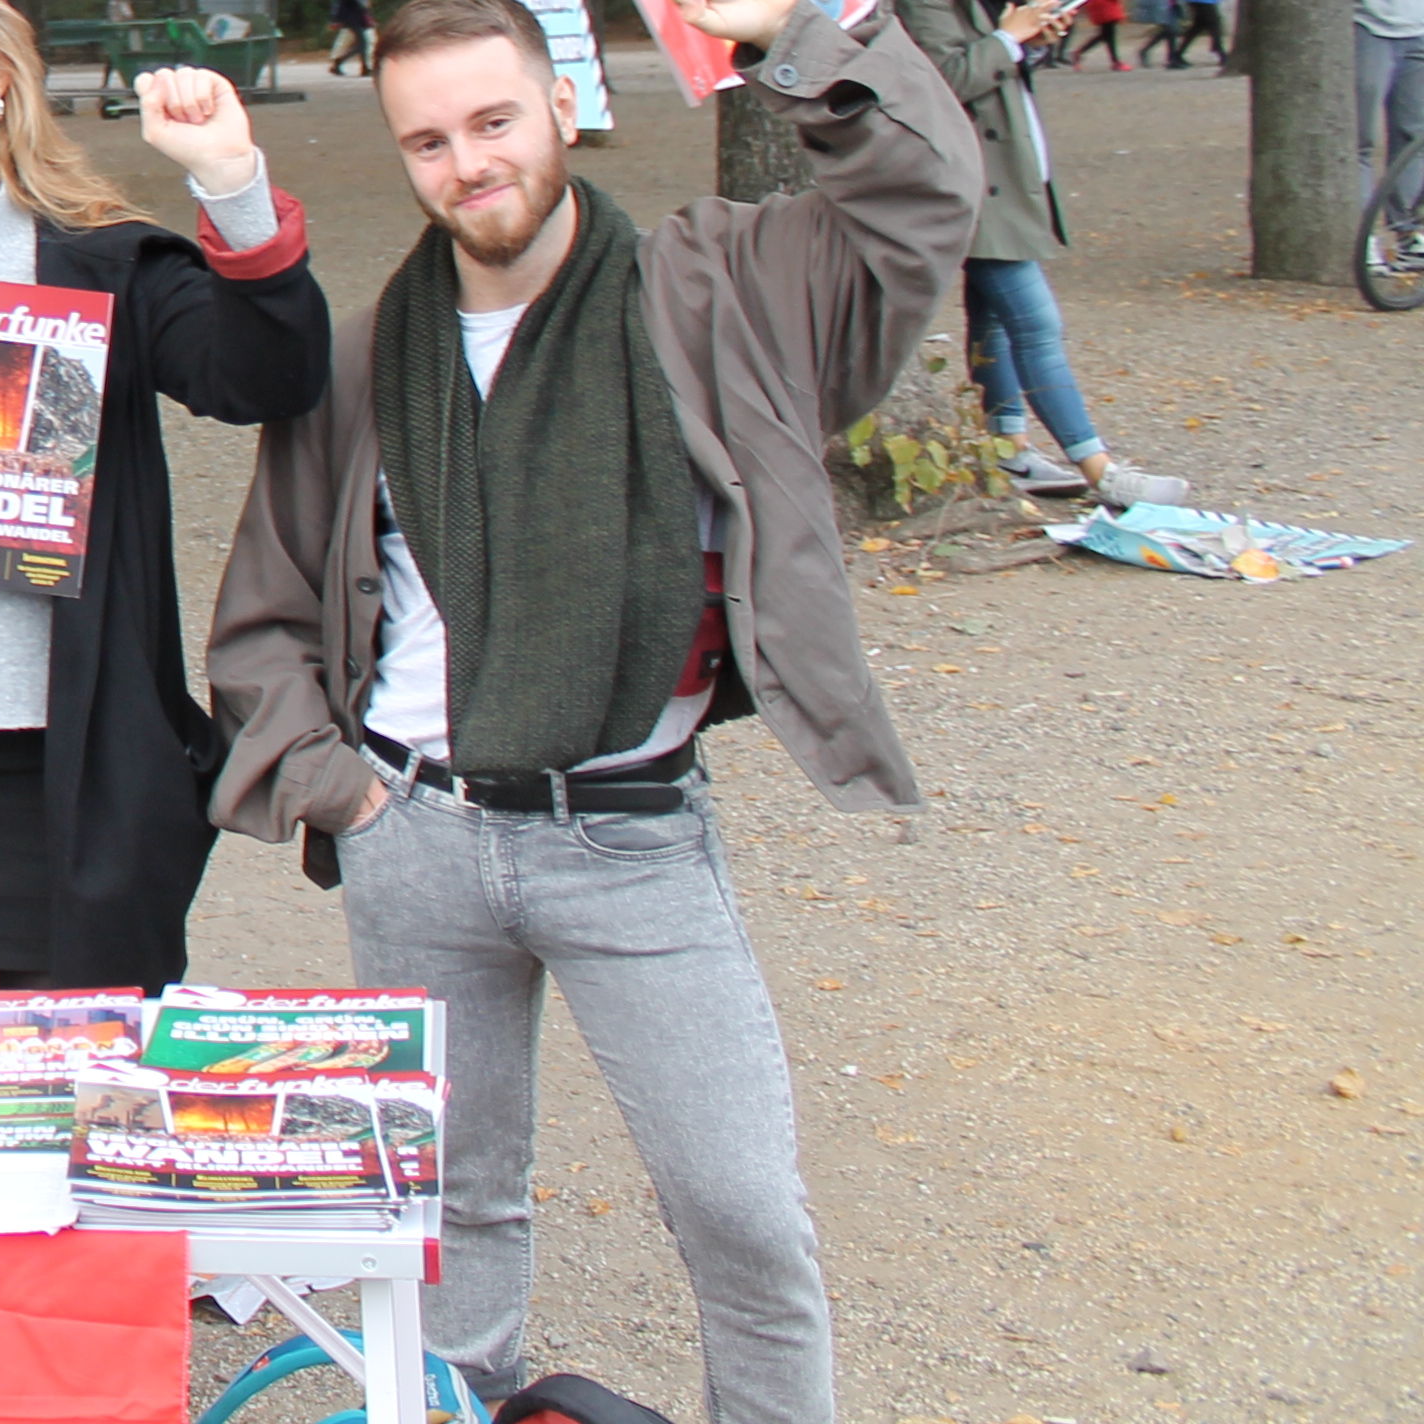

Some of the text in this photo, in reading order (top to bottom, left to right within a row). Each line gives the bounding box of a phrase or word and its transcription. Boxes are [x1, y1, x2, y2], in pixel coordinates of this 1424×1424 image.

[170, 1029, 410, 1042] ILLUSIONEN
[87, 1132, 361, 1150] REVOLUTIONÄRER
[86, 1138, 363, 1165] WANDEL
[85, 1153, 364, 1172] STATT KLIMAWANDEL
